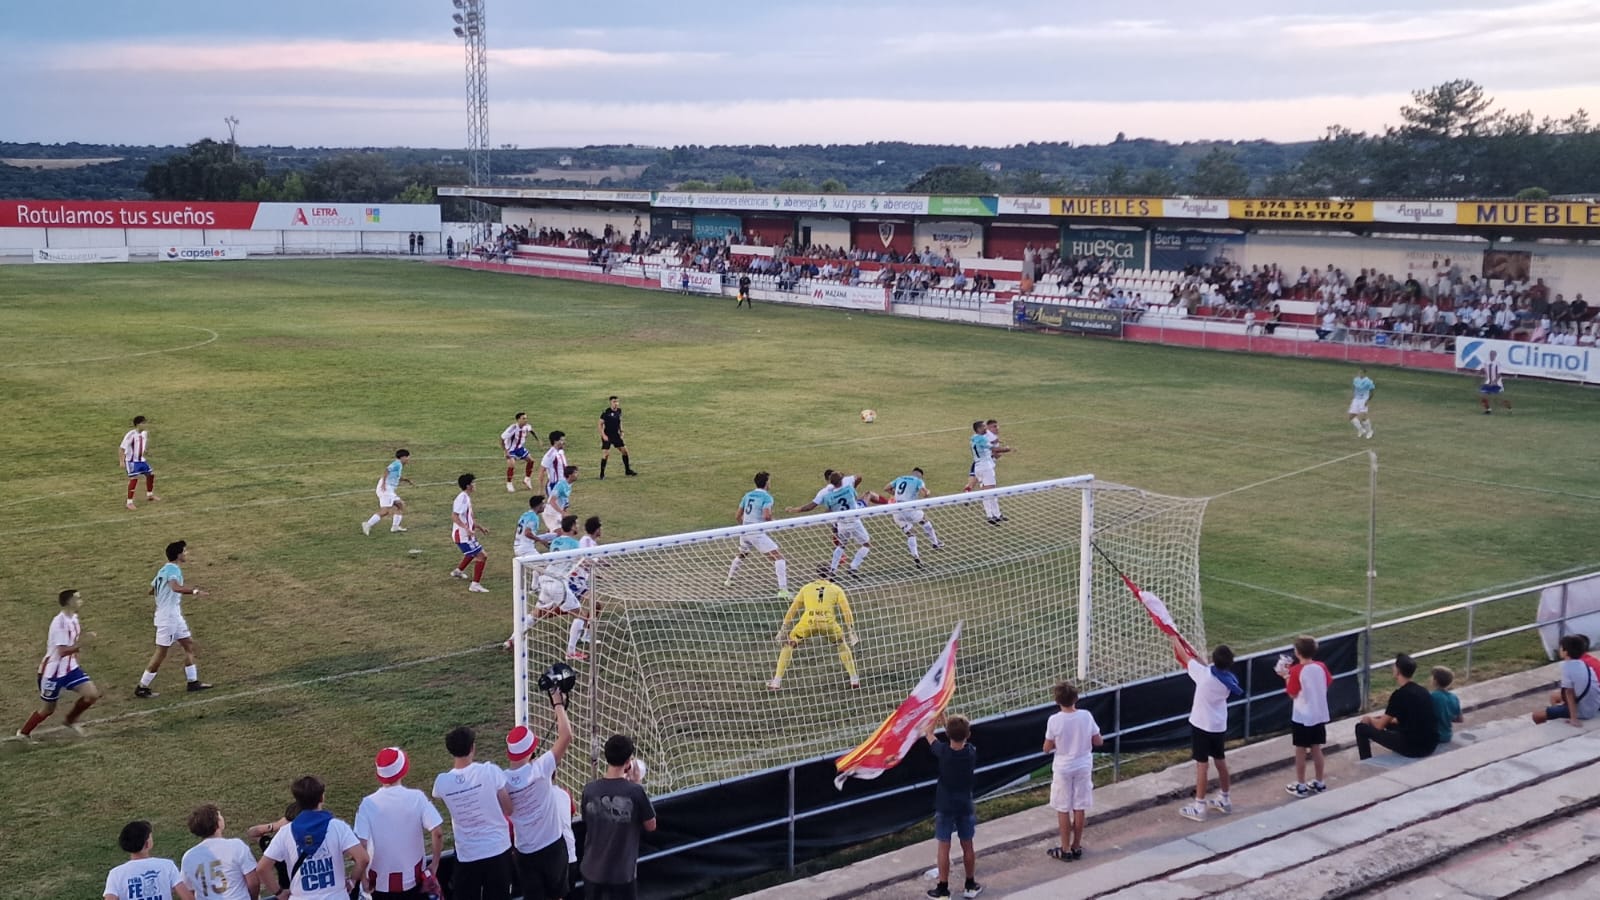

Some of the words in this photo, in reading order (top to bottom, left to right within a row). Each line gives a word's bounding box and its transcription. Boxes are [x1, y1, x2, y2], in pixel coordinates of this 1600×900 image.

[312, 207, 338, 216] LETRA
[844, 200, 851, 210] y
[852, 200, 866, 211] gas
[1061, 199, 1150, 216] MUEBLES
[1260, 201, 1286, 209] 974
[1315, 202, 1331, 210] 18
[1337, 202, 1355, 210] 77
[17, 204, 114, 224] Rotulamos
[119, 208, 148, 224] tus
[152, 206, 216, 225] sueños
[1244, 210, 1355, 220] BARBASTRO
[1154, 233, 1182, 245] Berta
[180, 247, 226, 258] capselos
[1508, 344, 1589, 372] Climol
[898, 480, 907, 495] 9
[744, 498, 753, 514] 5
[837, 497, 850, 511] 3
[194, 859, 229, 895] 15
[301, 870, 336, 892] CA
[128, 884, 143, 899] FE
